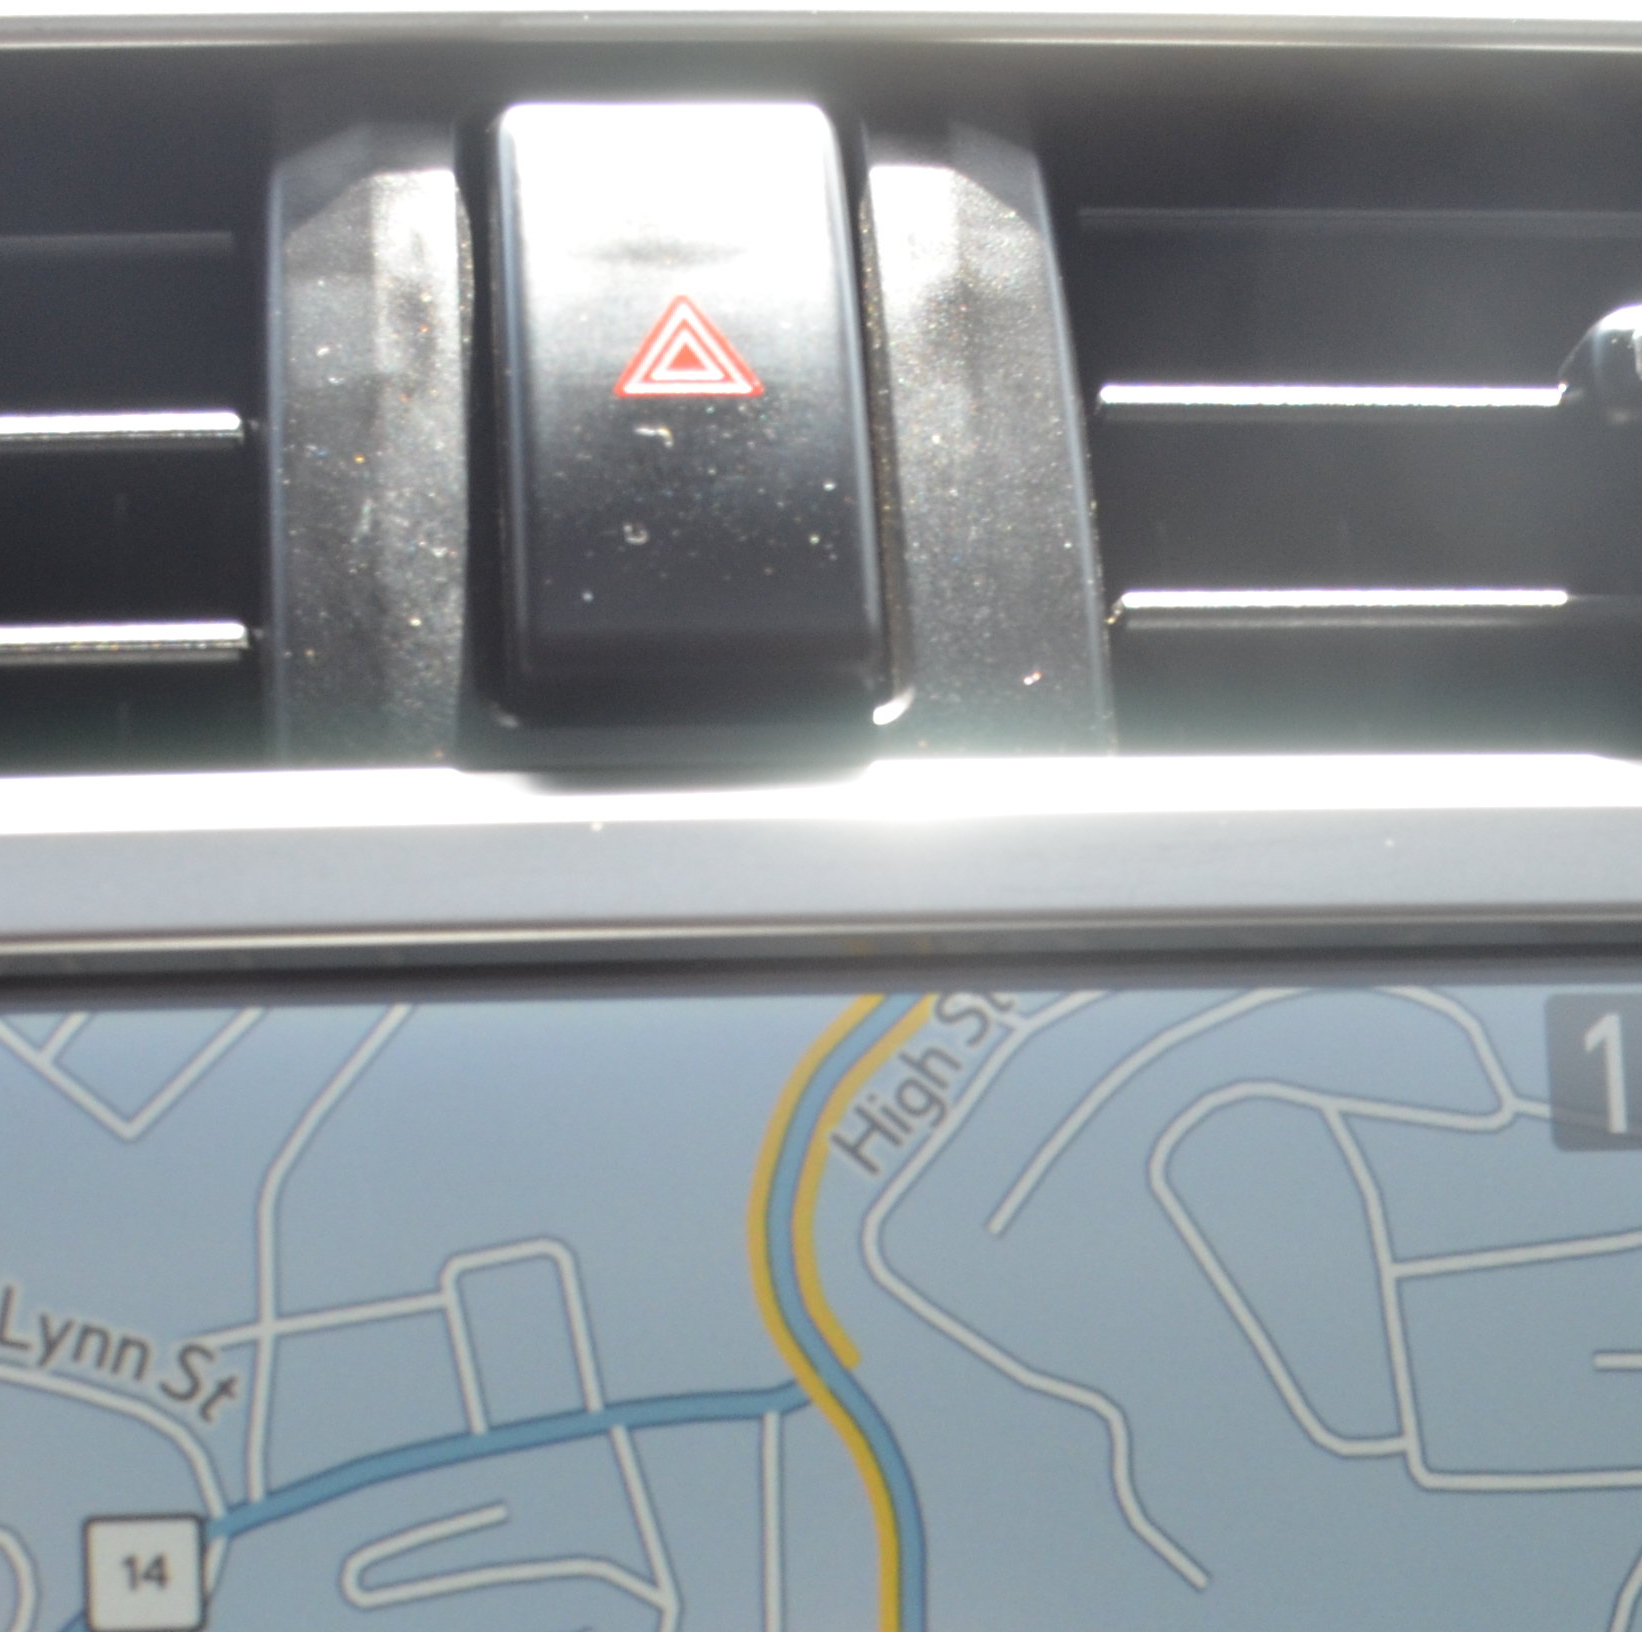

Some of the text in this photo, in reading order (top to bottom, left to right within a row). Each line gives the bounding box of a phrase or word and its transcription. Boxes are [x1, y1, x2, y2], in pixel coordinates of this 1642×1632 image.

[830, 1046, 963, 1177] High
[160, 1342, 239, 1423] St
[123, 1554, 170, 1590] 14
